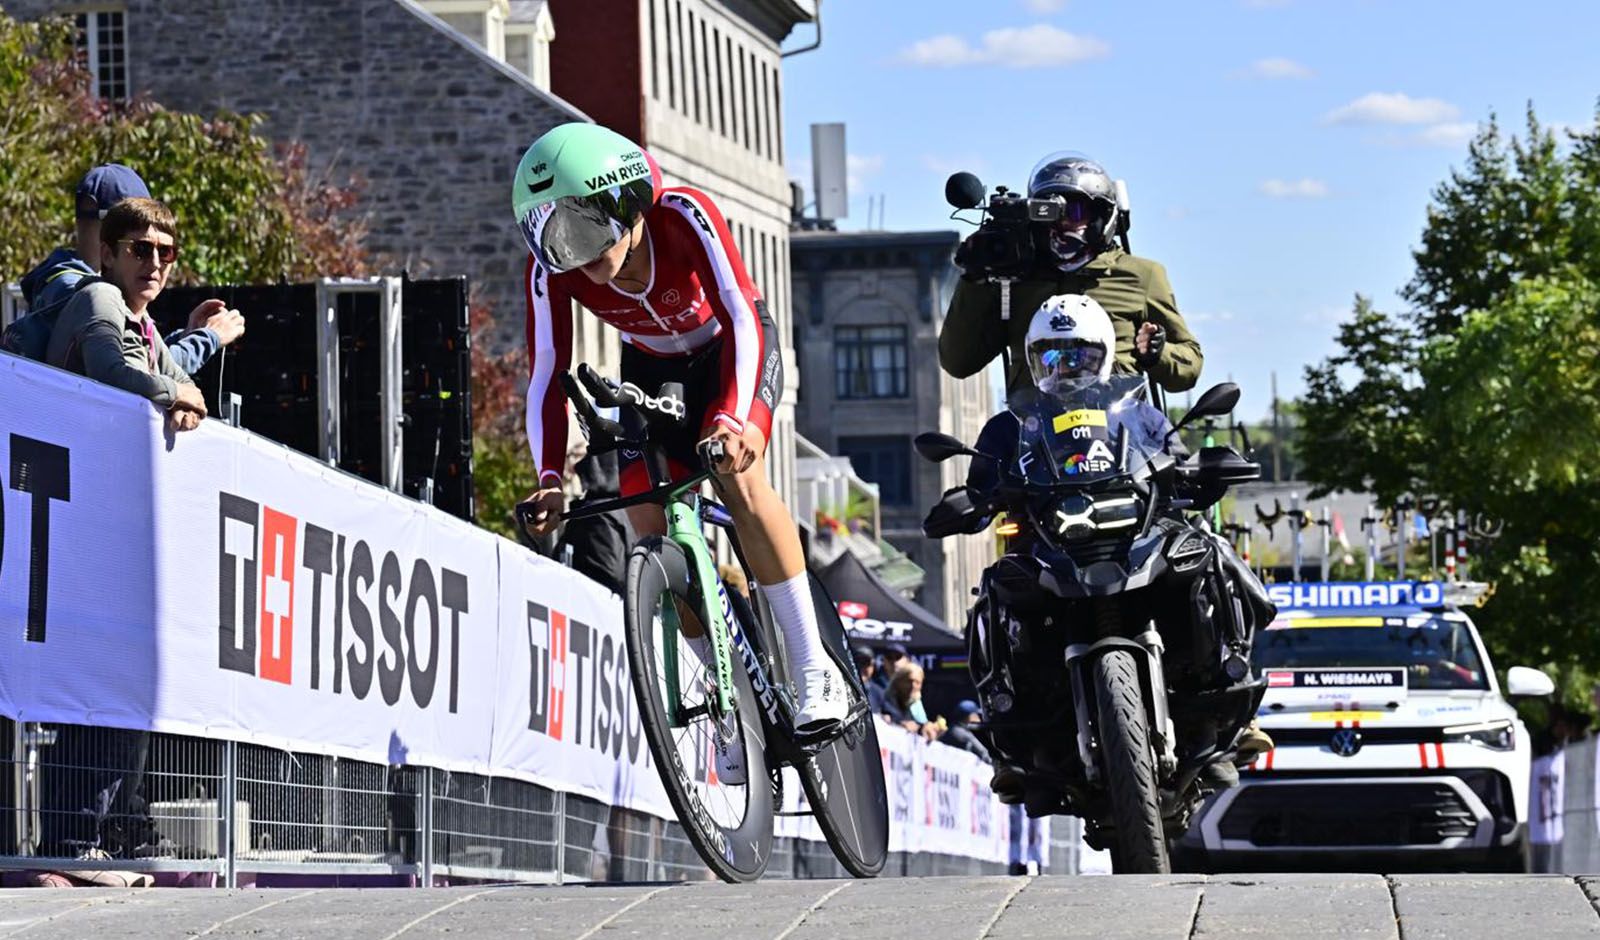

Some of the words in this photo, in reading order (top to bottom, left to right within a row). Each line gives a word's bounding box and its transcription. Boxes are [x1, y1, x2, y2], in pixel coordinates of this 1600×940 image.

[584, 171, 618, 191] VAN
[618, 162, 649, 181] RYSEL
[1068, 414, 1082, 423] TV
[1078, 460, 1112, 472] NEP
[1268, 583, 1441, 608] SHIMANO
[303, 521, 469, 715] TISSOT
[1304, 673, 1319, 685] N.
[1320, 673, 1394, 685] WIESMAYR
[570, 618, 650, 769] TISSO
